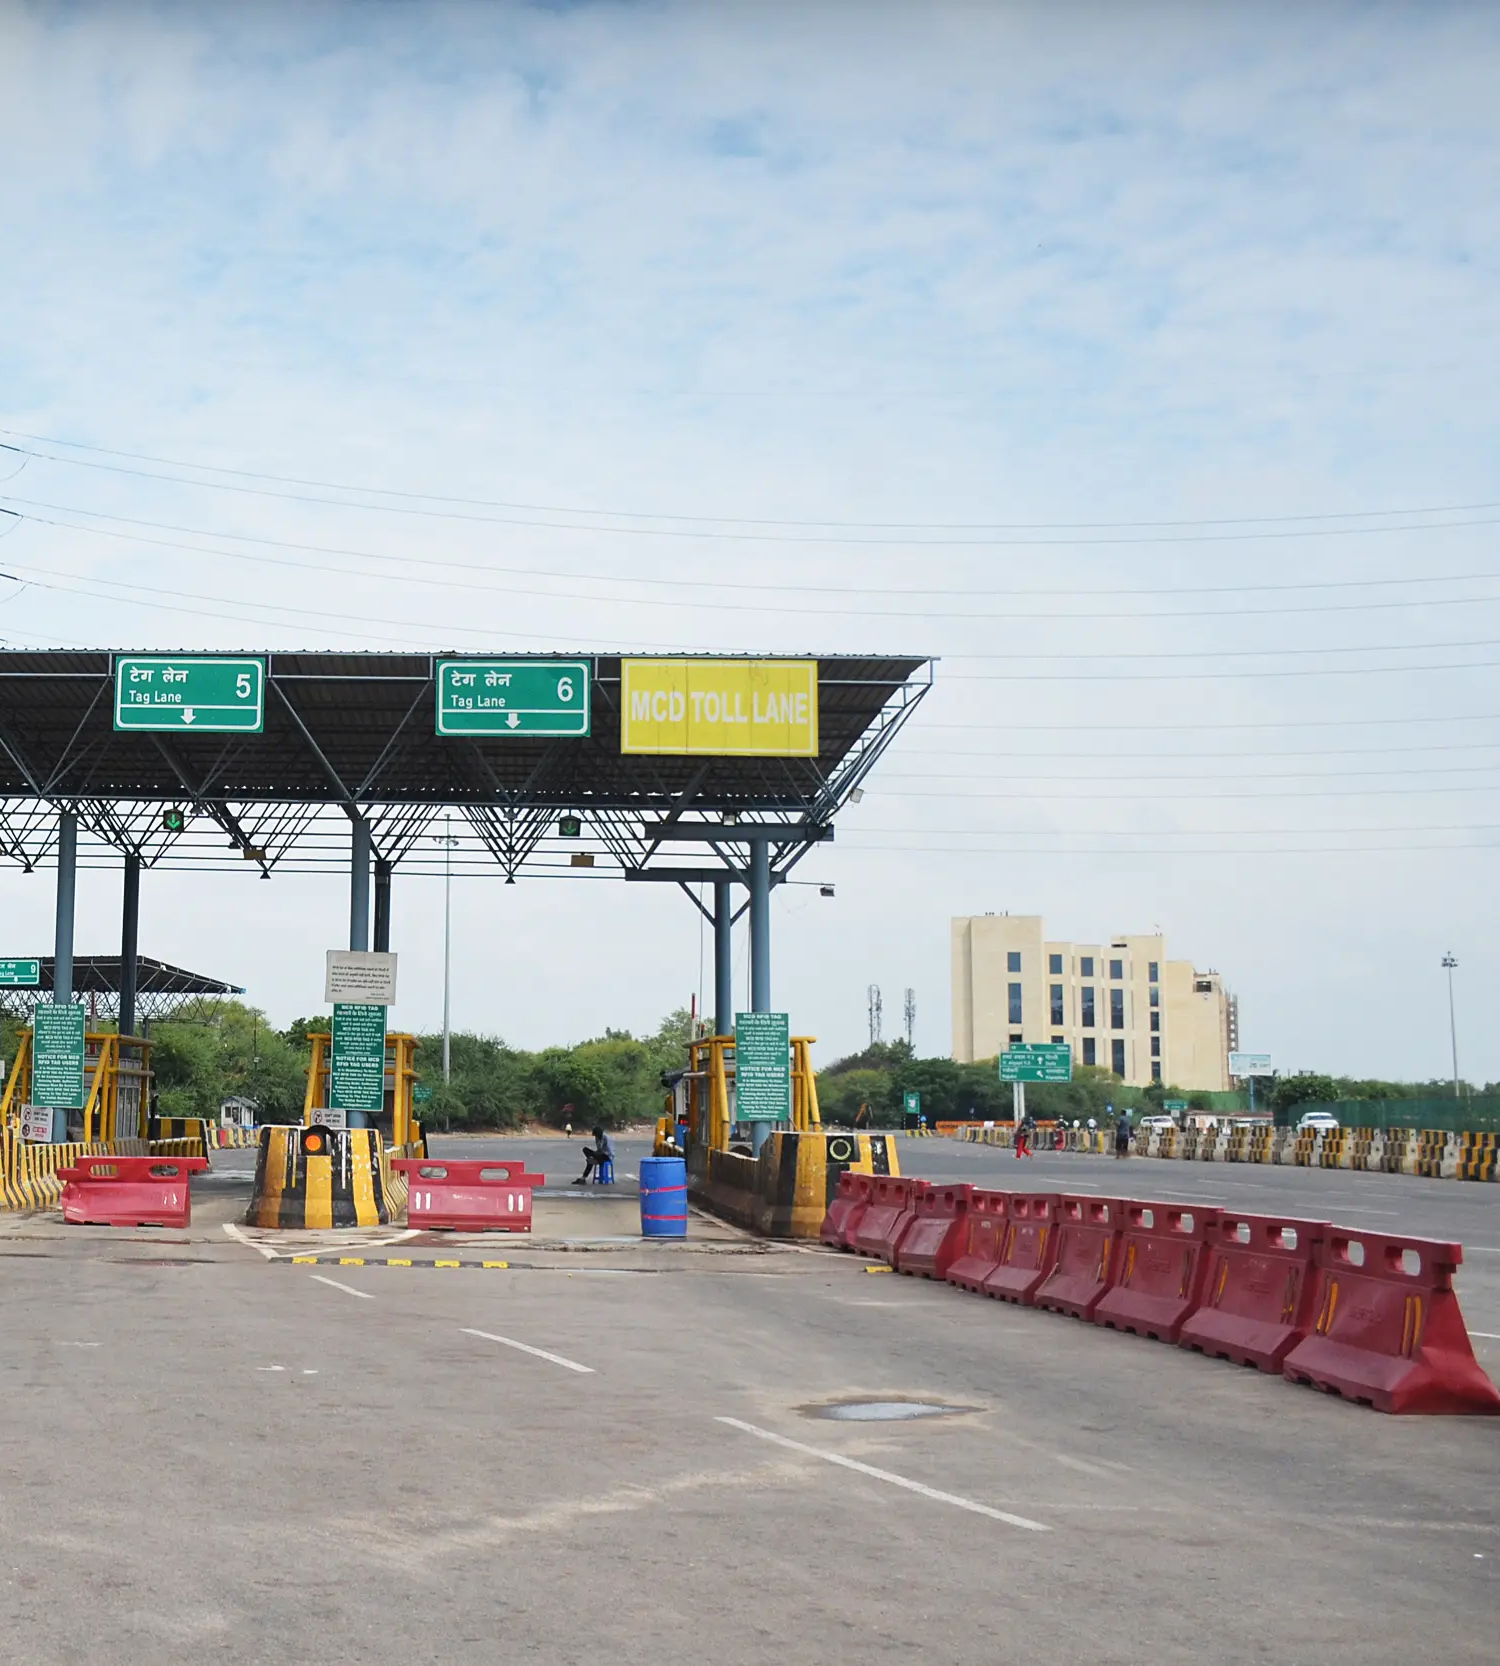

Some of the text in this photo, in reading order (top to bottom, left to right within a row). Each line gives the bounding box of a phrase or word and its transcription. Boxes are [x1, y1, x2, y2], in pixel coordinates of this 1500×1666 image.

[129, 666, 189, 684] टेग लेन
[451, 670, 512, 687] टेग लेन
[235, 673, 251, 699] 5
[557, 676, 574, 702] 6
[129, 690, 182, 705] Tag Lane
[451, 694, 506, 710] Tag Lane
[631, 690, 808, 725] MCD TOLL LANE
[30, 964, 37, 974] 9
